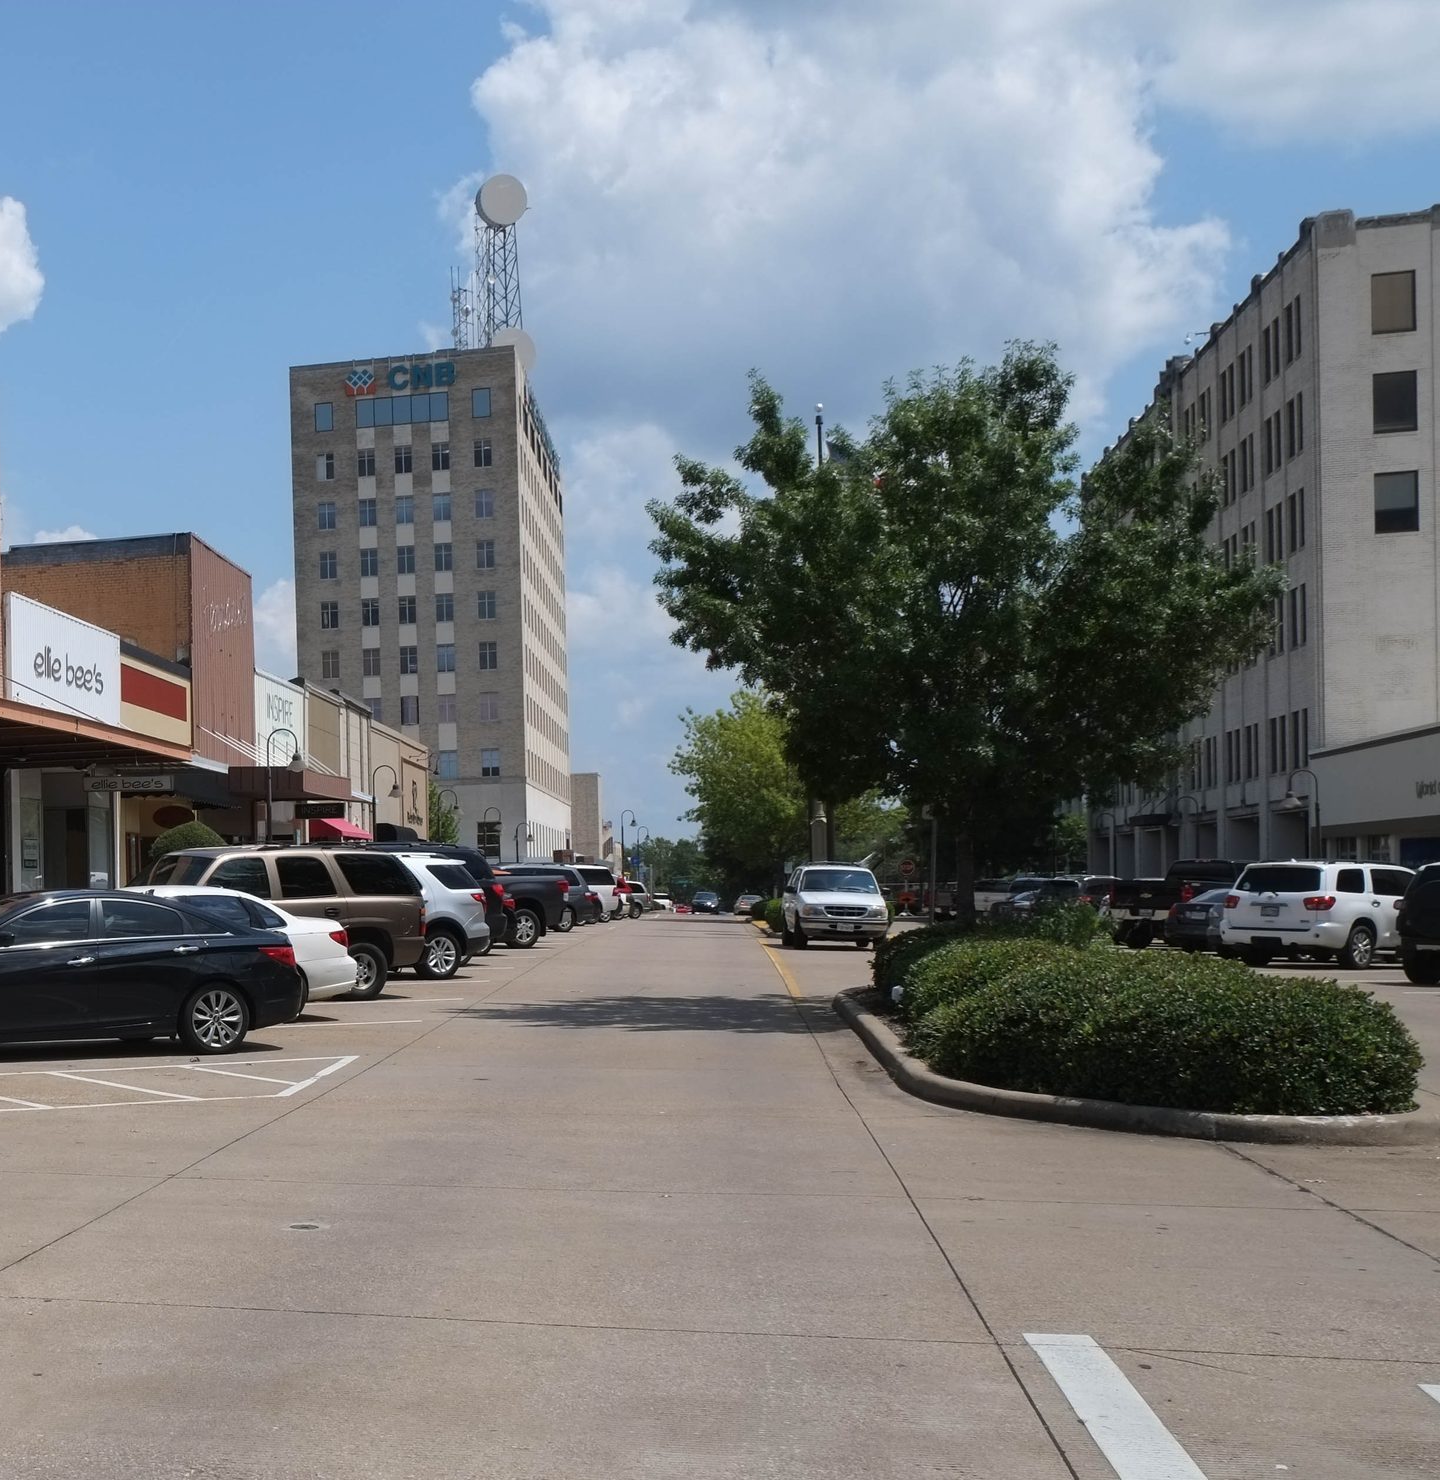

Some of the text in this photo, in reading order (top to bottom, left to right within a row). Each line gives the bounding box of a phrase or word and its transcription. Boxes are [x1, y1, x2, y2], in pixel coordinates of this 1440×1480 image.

[388, 361, 456, 390] CNB
[33, 646, 104, 695] ellie bee's
[267, 692, 294, 728] INSPIRE
[91, 777, 164, 791] ellie bee's
[302, 805, 338, 814] INSPIRE
